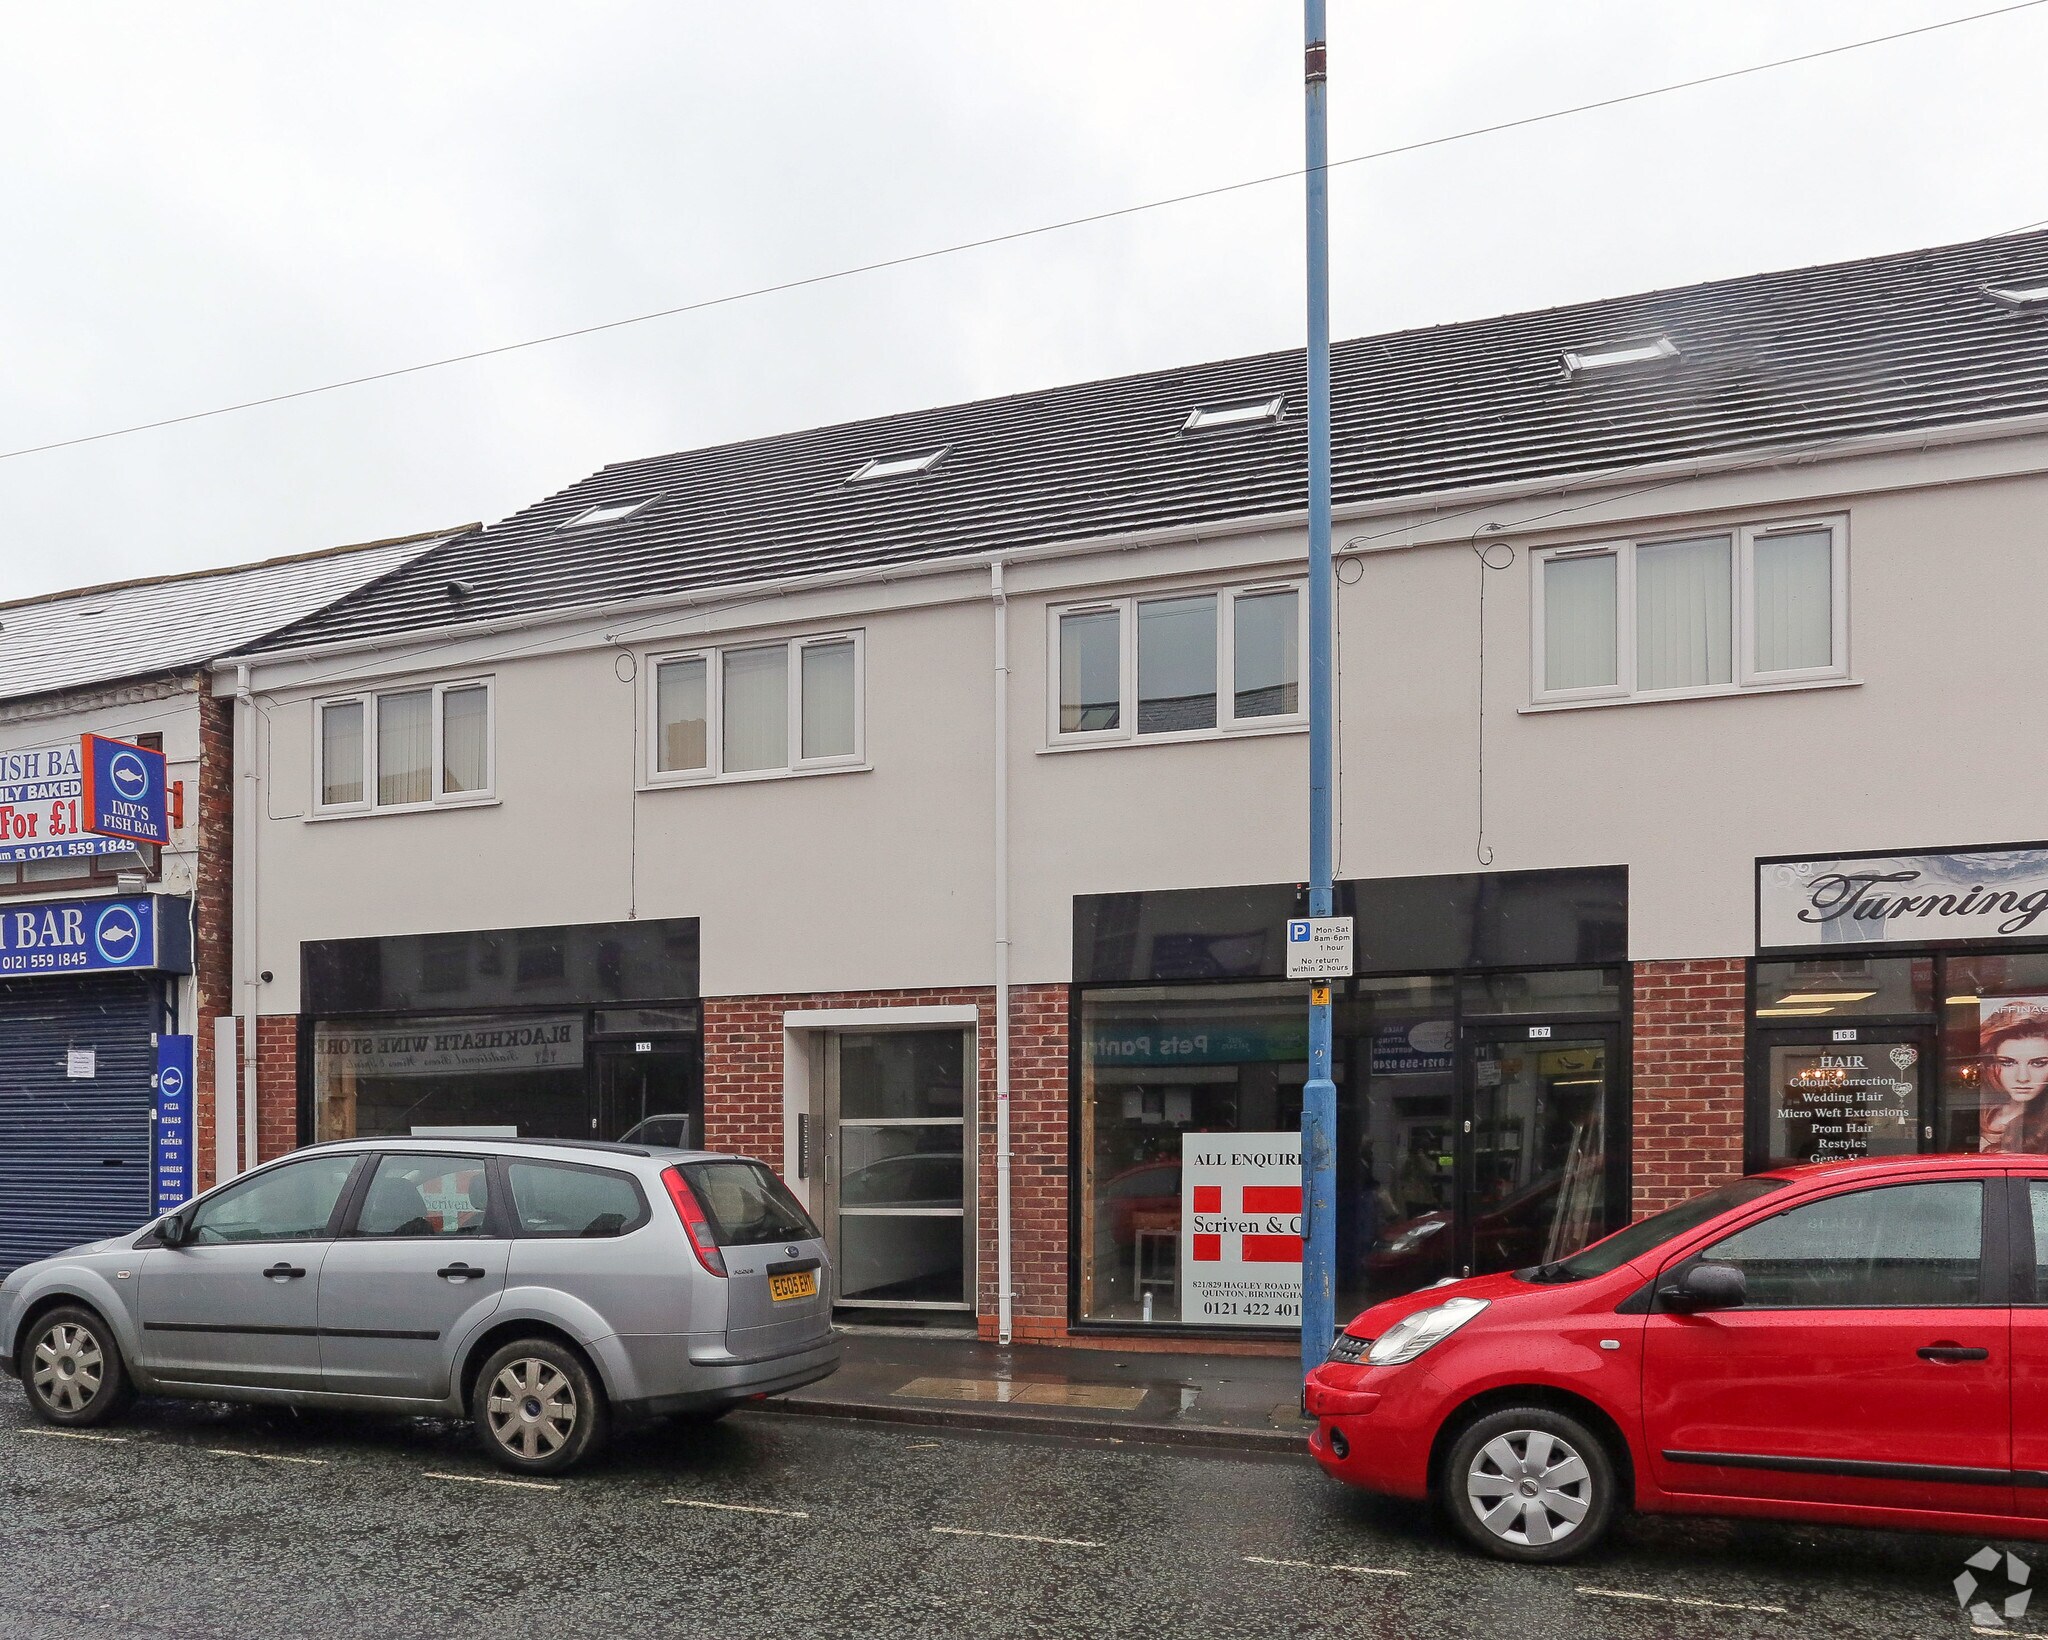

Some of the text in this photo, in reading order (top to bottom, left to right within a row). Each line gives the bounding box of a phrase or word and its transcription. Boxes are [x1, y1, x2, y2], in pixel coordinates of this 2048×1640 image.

[27, 780, 81, 799] BAKED
[112, 800, 149, 820] IMY'S
[0, 799, 78, 840] For £1
[103, 814, 158, 836] FISH BAR
[29, 845, 63, 858] 0121
[68, 842, 95, 855] 559
[99, 839, 135, 852] 1845
[1798, 870, 2048, 934] Turning
[15, 909, 86, 949] BAR
[1294, 924, 1306, 940] P
[2, 952, 87, 970] 0121 559 1845
[1317, 989, 1324, 998] 2
[1531, 1028, 1549, 1036] 167
[1835, 1031, 1855, 1039] 168
[1820, 1056, 1865, 1068] HAIR
[1789, 1076, 1895, 1087] Colour Correction
[1803, 1092, 1883, 1103] Wedding Hair
[1778, 1107, 1909, 1118] Micro Weft Extensions
[1812, 1123, 1873, 1133] Prom Hair
[1819, 1138, 1867, 1150] Restyles
[1194, 1153, 1227, 1166] ALL
[1194, 1215, 1260, 1233] Scriven
[1266, 1217, 1284, 1233] &
[773, 1276, 799, 1297] EG05
[1192, 1281, 1222, 1289] 821/829
[1223, 1282, 1262, 1290] HAGLEY
[1264, 1282, 1291, 1290] ROAD
[1202, 1289, 1247, 1298] QUINTON,
[1204, 1302, 1300, 1317] 0121 422 401
